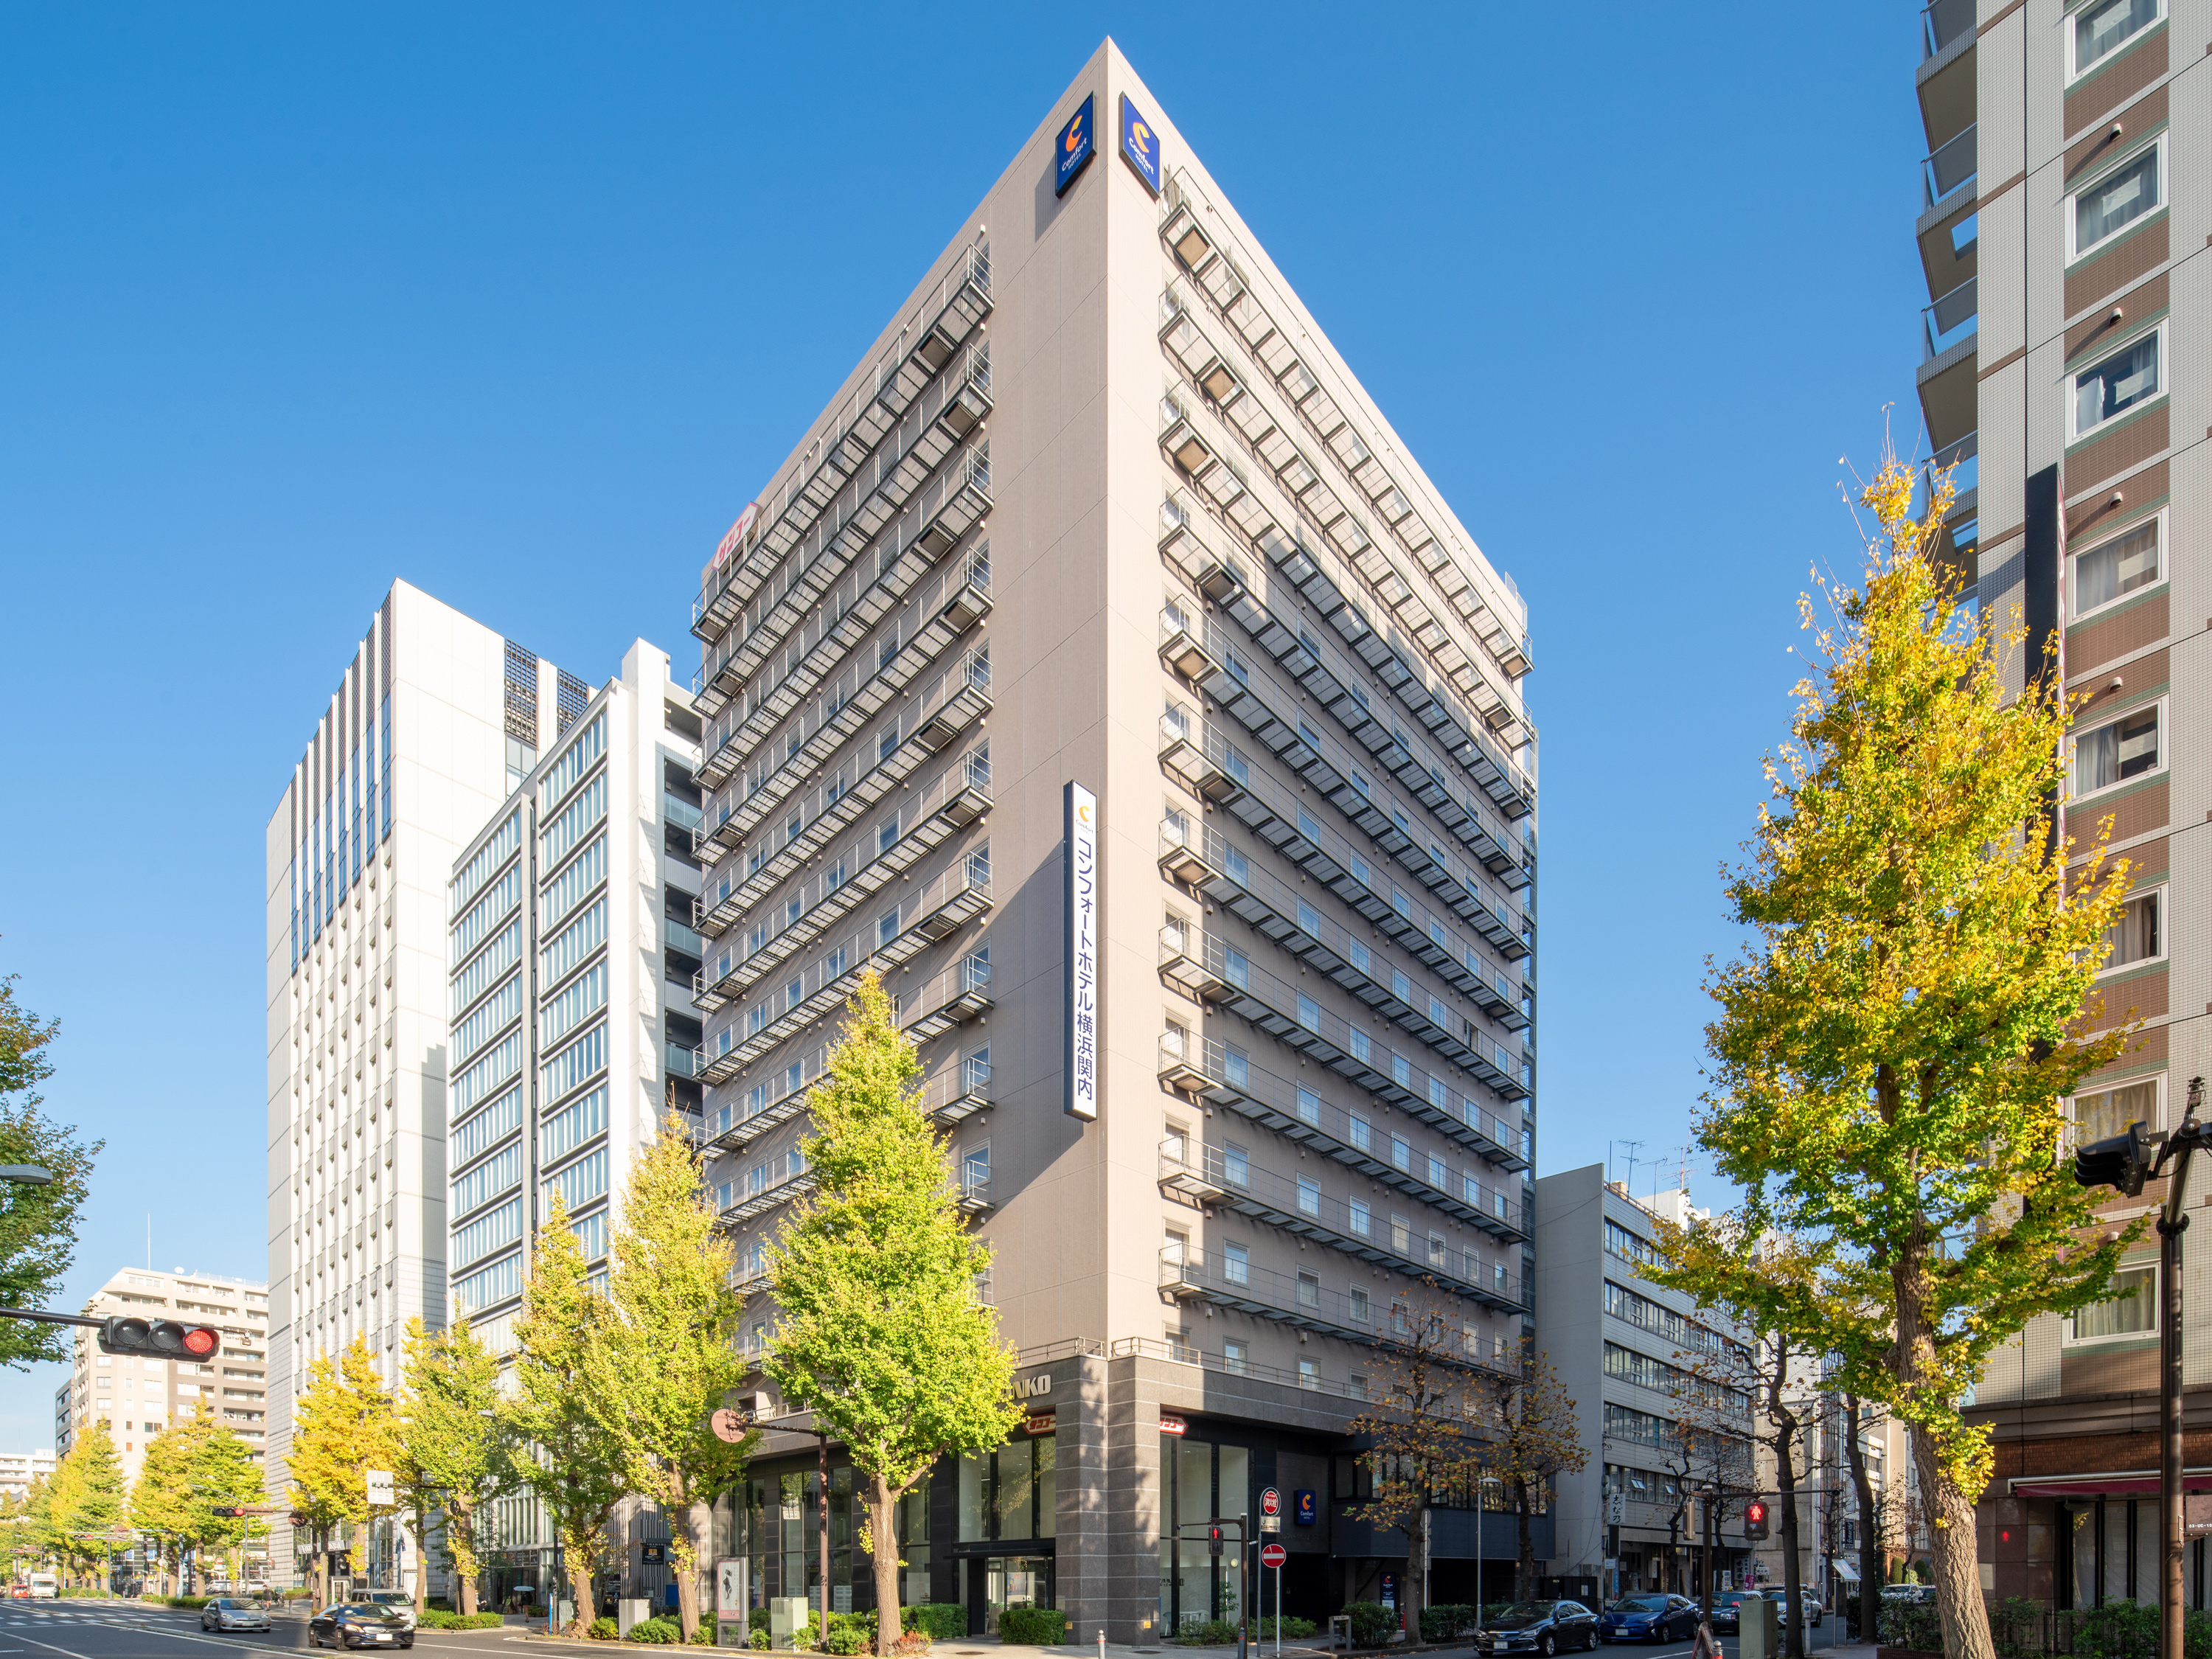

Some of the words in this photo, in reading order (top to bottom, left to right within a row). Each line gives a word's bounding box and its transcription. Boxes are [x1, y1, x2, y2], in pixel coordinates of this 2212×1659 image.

[1062, 137, 1088, 172] Comfort
[1068, 153, 1082, 170] HOTEL
[1129, 137, 1155, 175] Comfort
[1135, 153, 1149, 173] HOTEL
[718, 515, 751, 566] サンコー
[1076, 818, 1093, 834] Comfort
[1077, 837, 1093, 1100] コンフォートホテル横浜関内
[1029, 1417, 1056, 1430] サンコー
[1265, 1498, 1277, 1507] 消火栓
